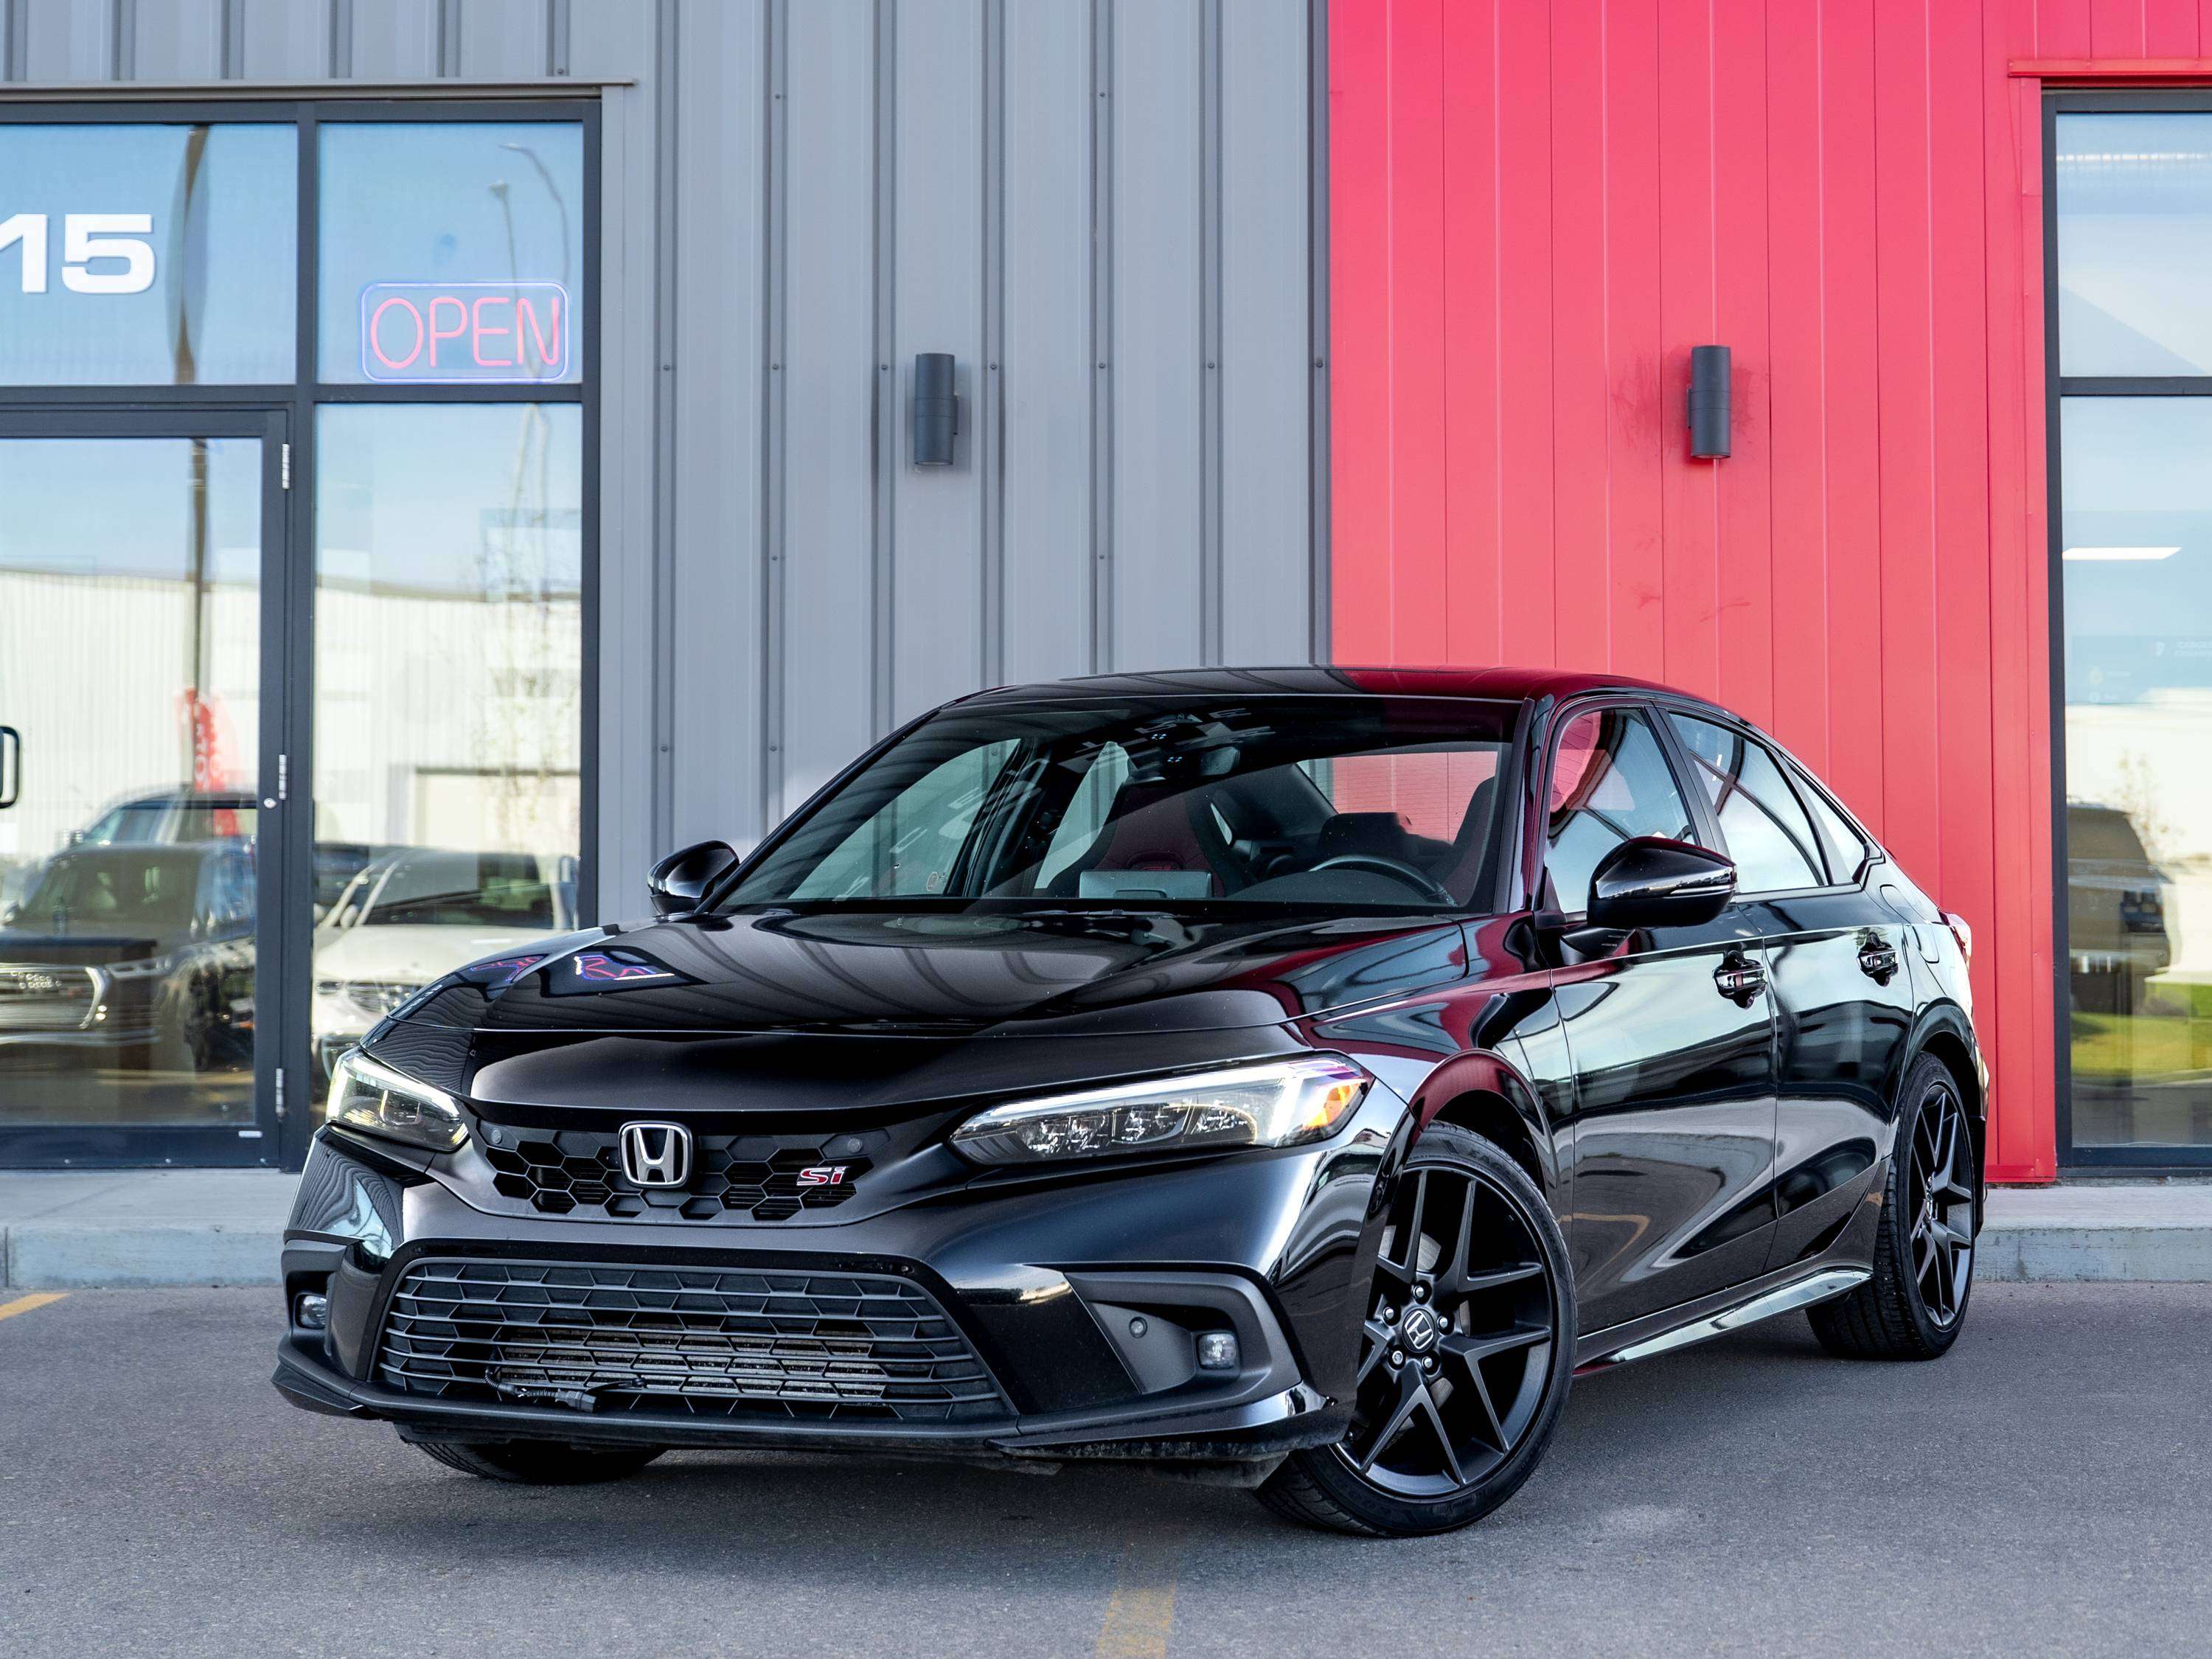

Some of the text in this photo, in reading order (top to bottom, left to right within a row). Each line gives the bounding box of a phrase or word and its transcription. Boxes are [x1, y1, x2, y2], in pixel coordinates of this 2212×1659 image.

[0, 214, 156, 294] 15
[370, 297, 559, 369] OPEN
[796, 1166, 846, 1186] Si
